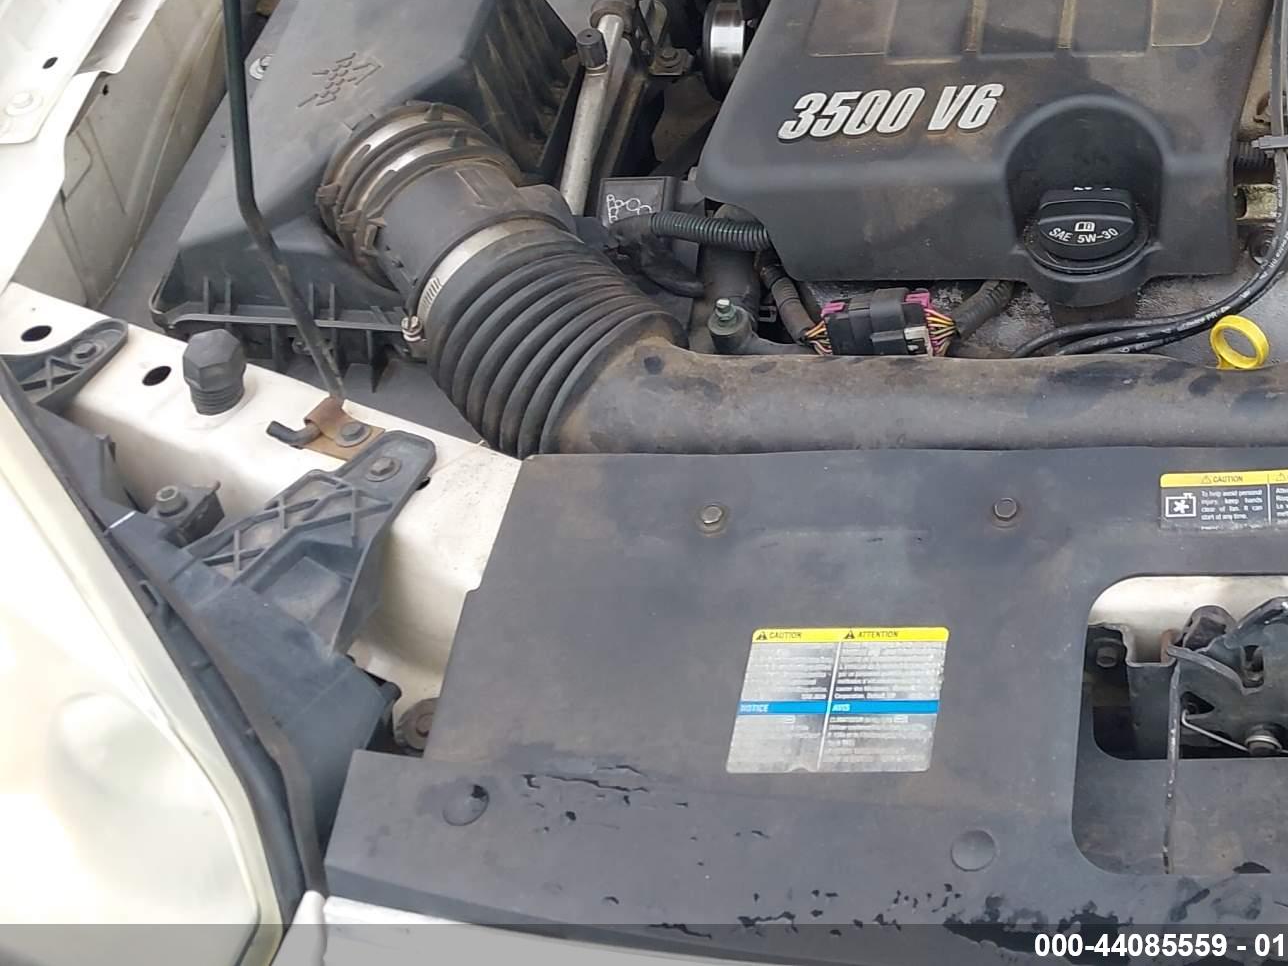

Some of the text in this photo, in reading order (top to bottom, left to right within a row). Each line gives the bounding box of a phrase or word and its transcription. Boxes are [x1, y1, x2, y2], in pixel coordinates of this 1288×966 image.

[777, 83, 1004, 140] 3500 V6
[1049, 227, 1119, 244] SAE 5W-30
[1212, 475, 1244, 483] CAUTION
[768, 631, 803, 640] CAUTION
[858, 630, 899, 638] ATTENTION
